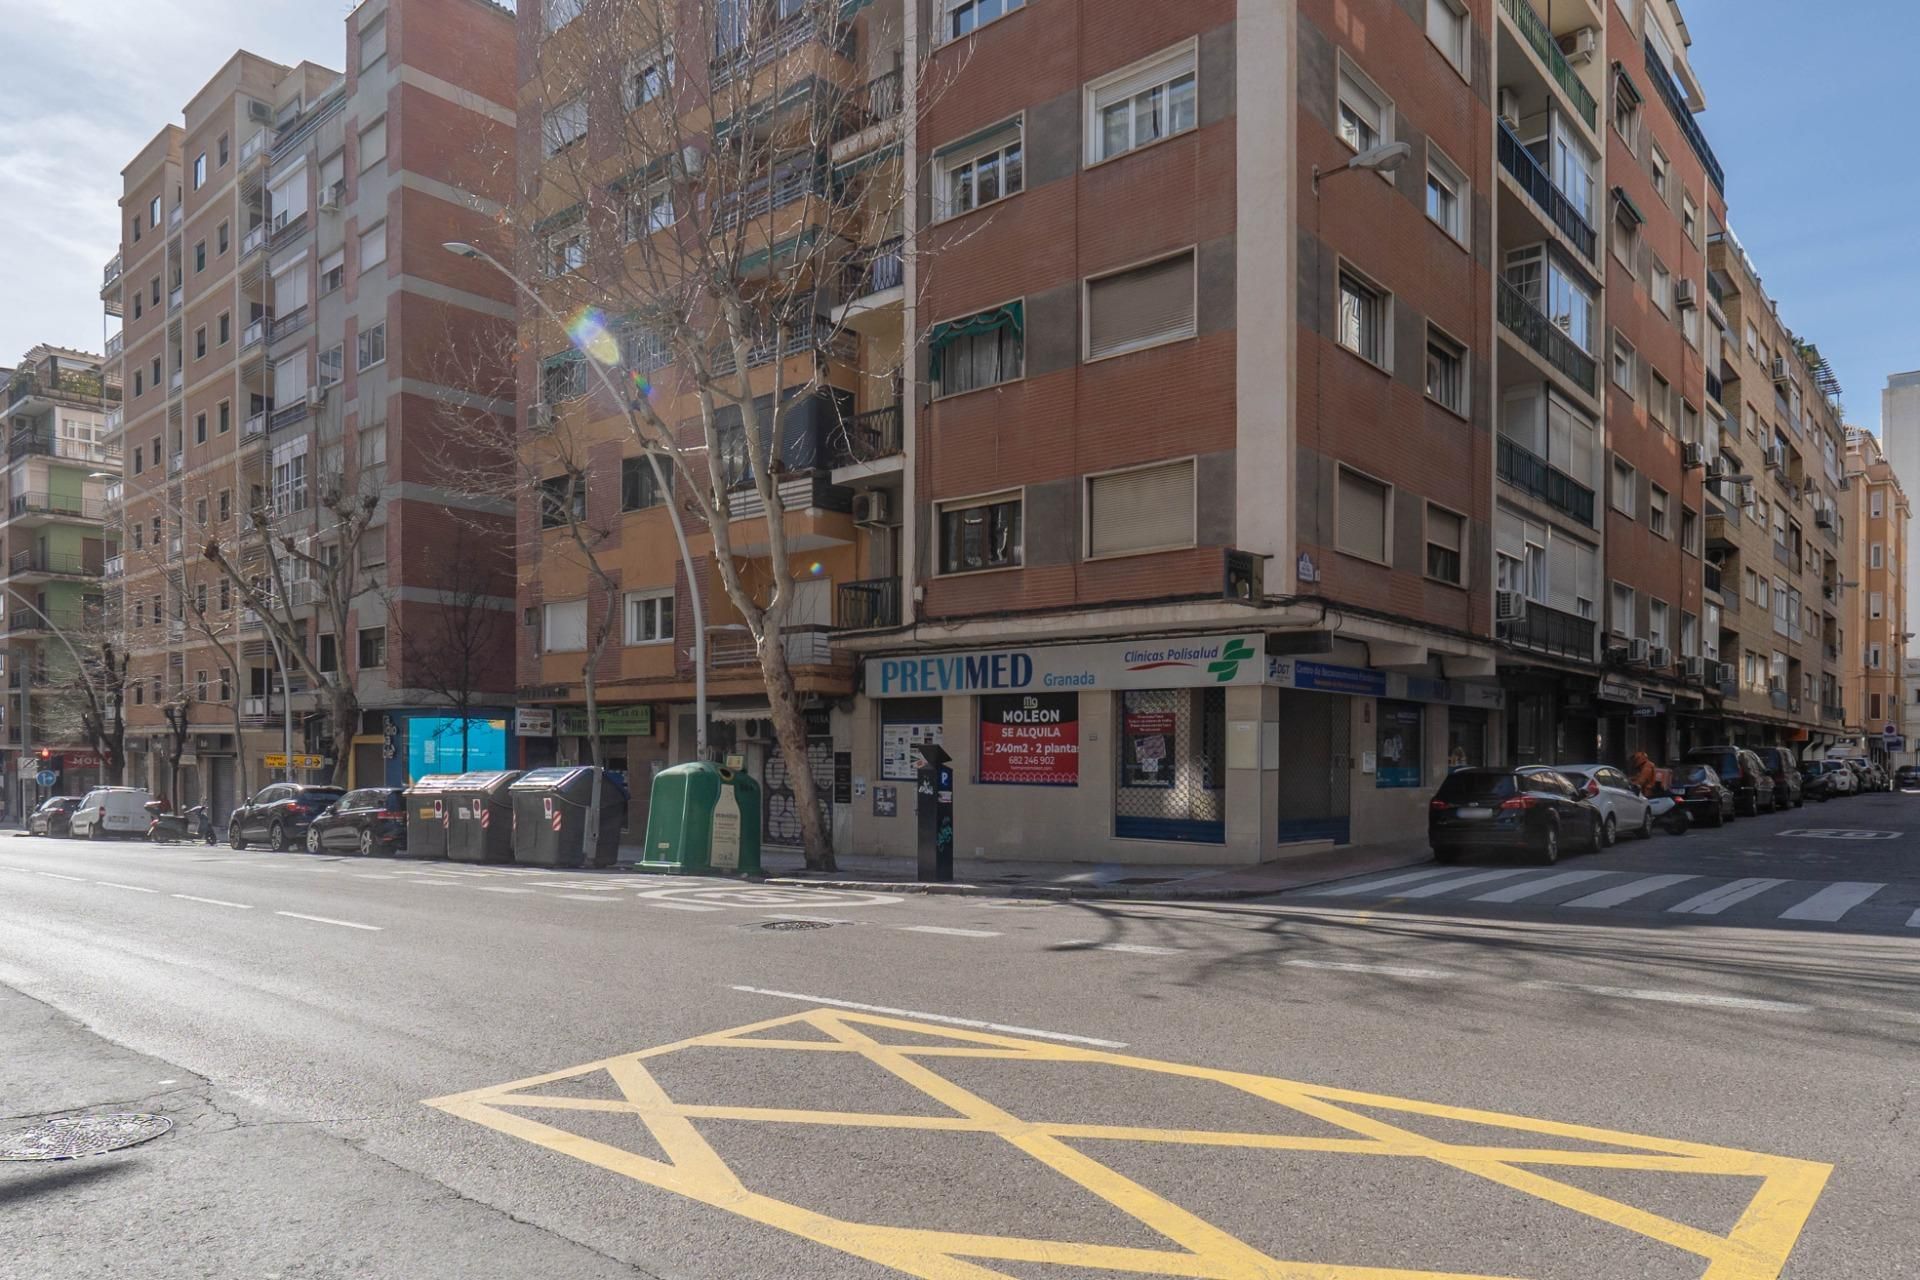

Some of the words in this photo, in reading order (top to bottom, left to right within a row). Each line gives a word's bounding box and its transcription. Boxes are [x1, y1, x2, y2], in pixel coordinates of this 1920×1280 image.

[1167, 646, 1219, 660] Polisalud
[881, 653, 1033, 693] PREVIMED
[1277, 663, 1290, 674] DGT
[1043, 671, 1095, 688] Granada
[1003, 709, 1060, 723] MOLEON
[1001, 727, 1014, 737] SE
[1016, 727, 1061, 738] ALQUILA
[995, 743, 1028, 753] 240m2
[1035, 743, 1042, 753] 2
[1008, 756, 1023, 765] 682
[1024, 756, 1039, 765] 246
[1039, 756, 1056, 765] 902
[941, 772, 949, 784] P
